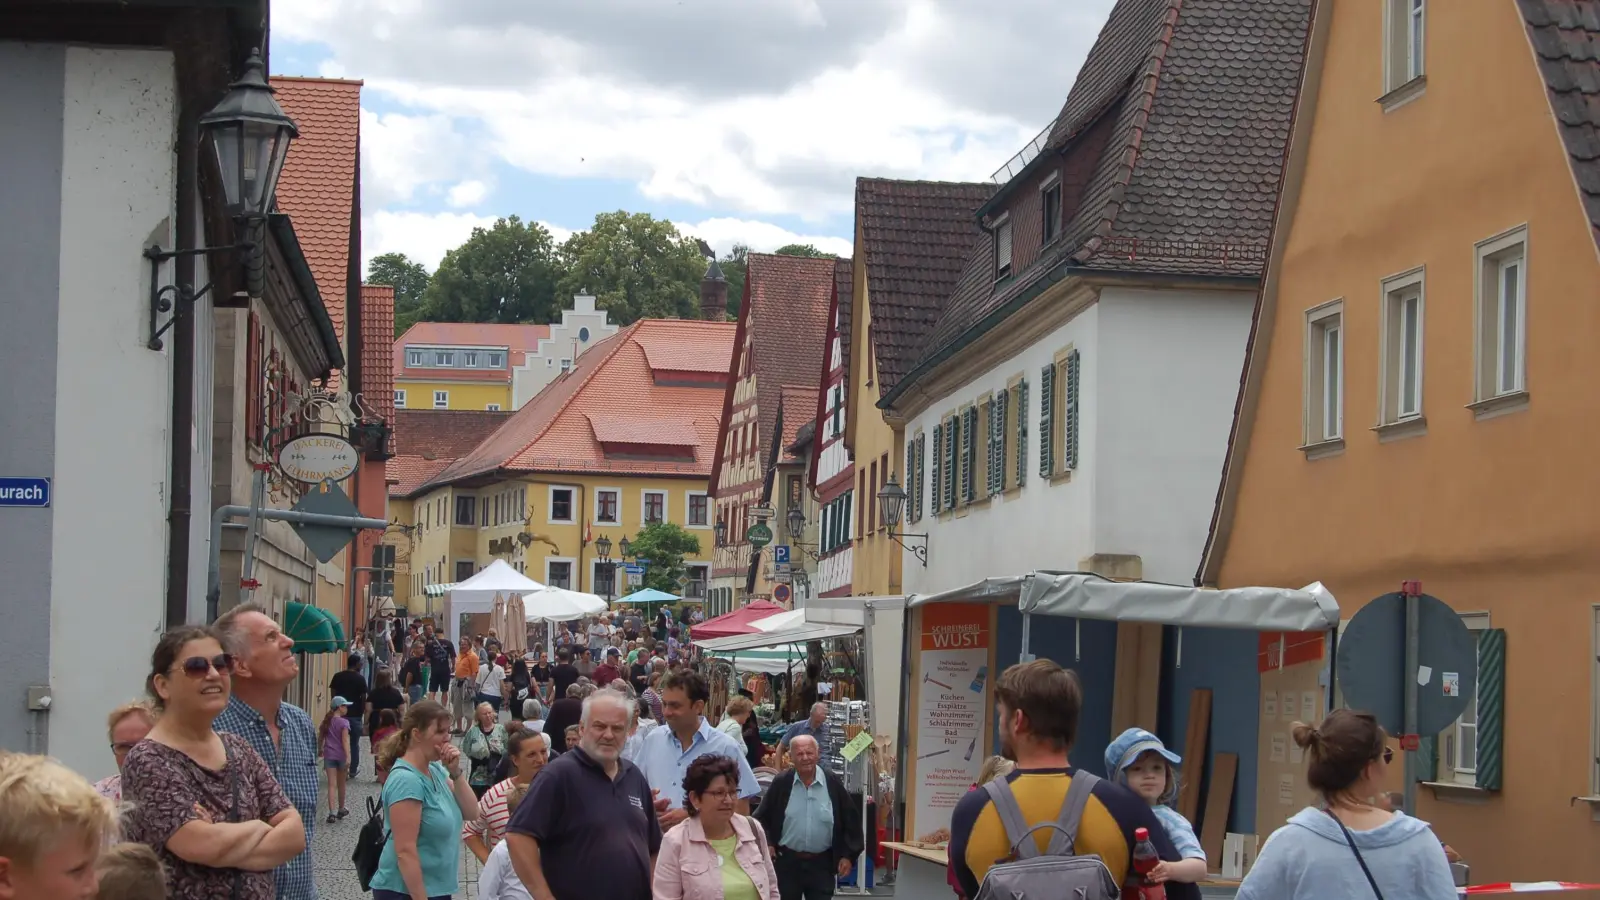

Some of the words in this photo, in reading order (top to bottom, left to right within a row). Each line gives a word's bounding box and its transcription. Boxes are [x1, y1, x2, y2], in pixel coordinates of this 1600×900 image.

[0, 484, 43, 499] urach
[777, 548, 785, 561] P
[940, 693, 965, 701] Küchen
[937, 702, 967, 710] Essplätze
[929, 711, 974, 719] Wohnzimmer
[928, 719, 974, 728] Schlafzimmer
